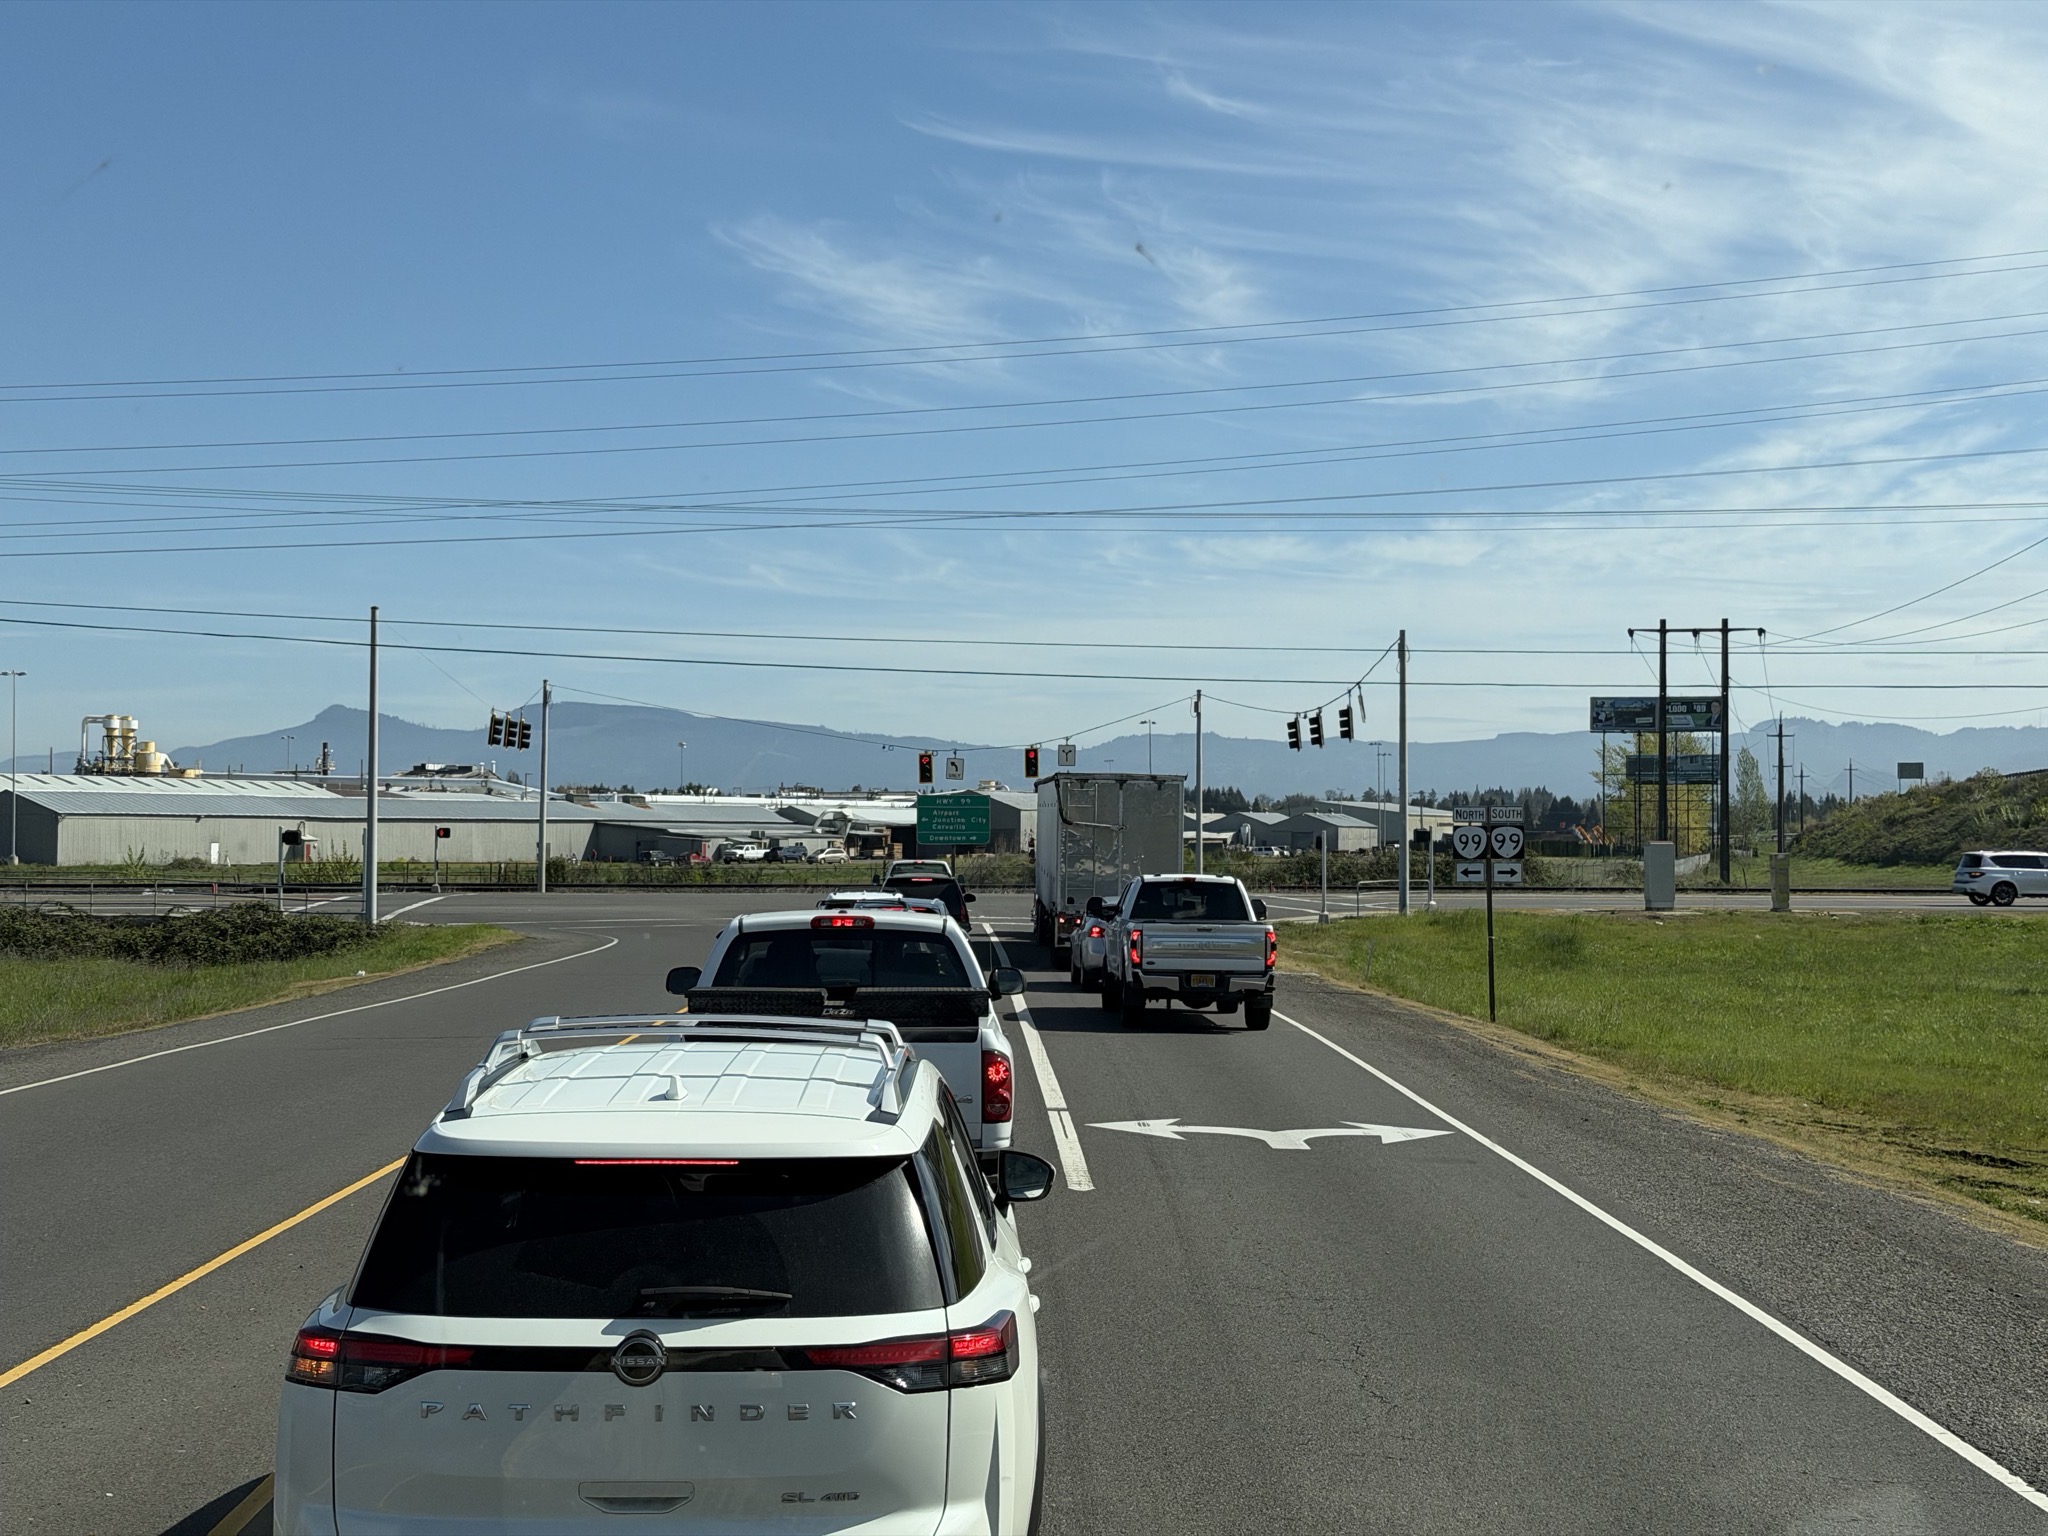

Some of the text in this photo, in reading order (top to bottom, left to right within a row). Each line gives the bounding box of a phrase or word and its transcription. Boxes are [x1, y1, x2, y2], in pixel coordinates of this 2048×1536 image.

[1455, 809, 1485, 820] NORTH
[1492, 808, 1522, 819] SOUTH
[1458, 833, 1482, 852] 99
[1494, 833, 1520, 851] 99
[420, 1401, 858, 1422] PATHFINDER
[781, 1492, 860, 1503] SL 4WD
